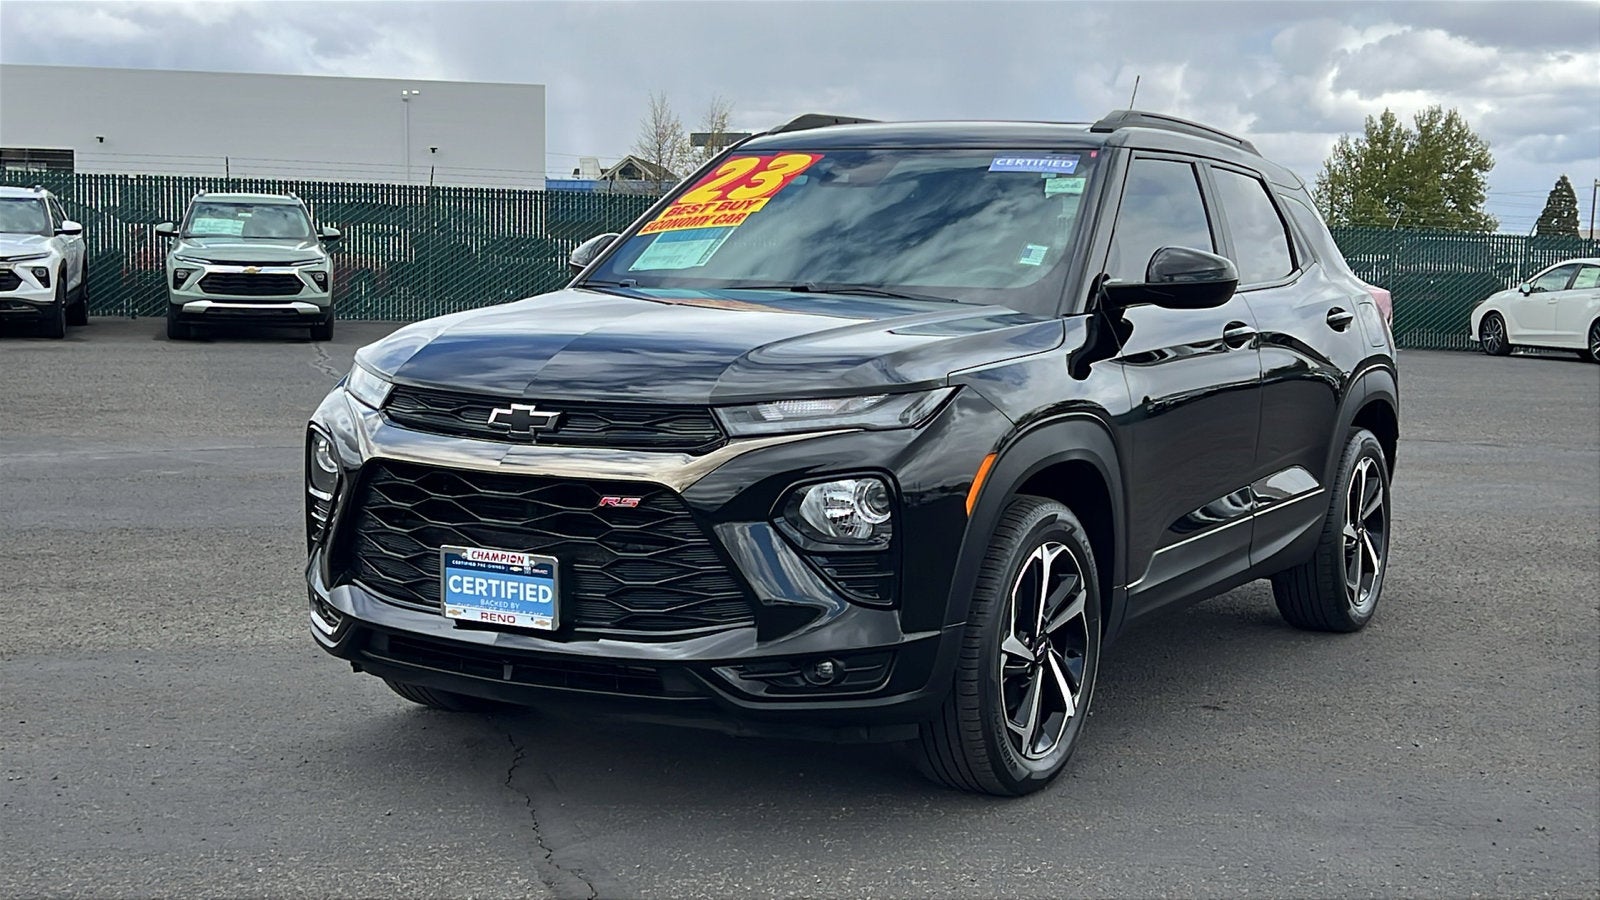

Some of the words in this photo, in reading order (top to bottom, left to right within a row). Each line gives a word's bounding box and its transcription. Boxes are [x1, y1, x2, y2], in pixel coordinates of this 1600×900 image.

[996, 159, 1073, 168] CERTIFIED
[677, 153, 813, 205] 23
[663, 202, 716, 218] BEST
[717, 199, 763, 213] BUY
[641, 214, 715, 233] ECONOMY
[712, 212, 747, 225] CAR
[599, 497, 641, 507] RS
[472, 551, 524, 565] CHAMPION
[448, 574, 553, 604] CERTIFIED
[480, 599, 508, 609] BACKED
[510, 601, 521, 609] BY
[480, 612, 516, 623] RENO
